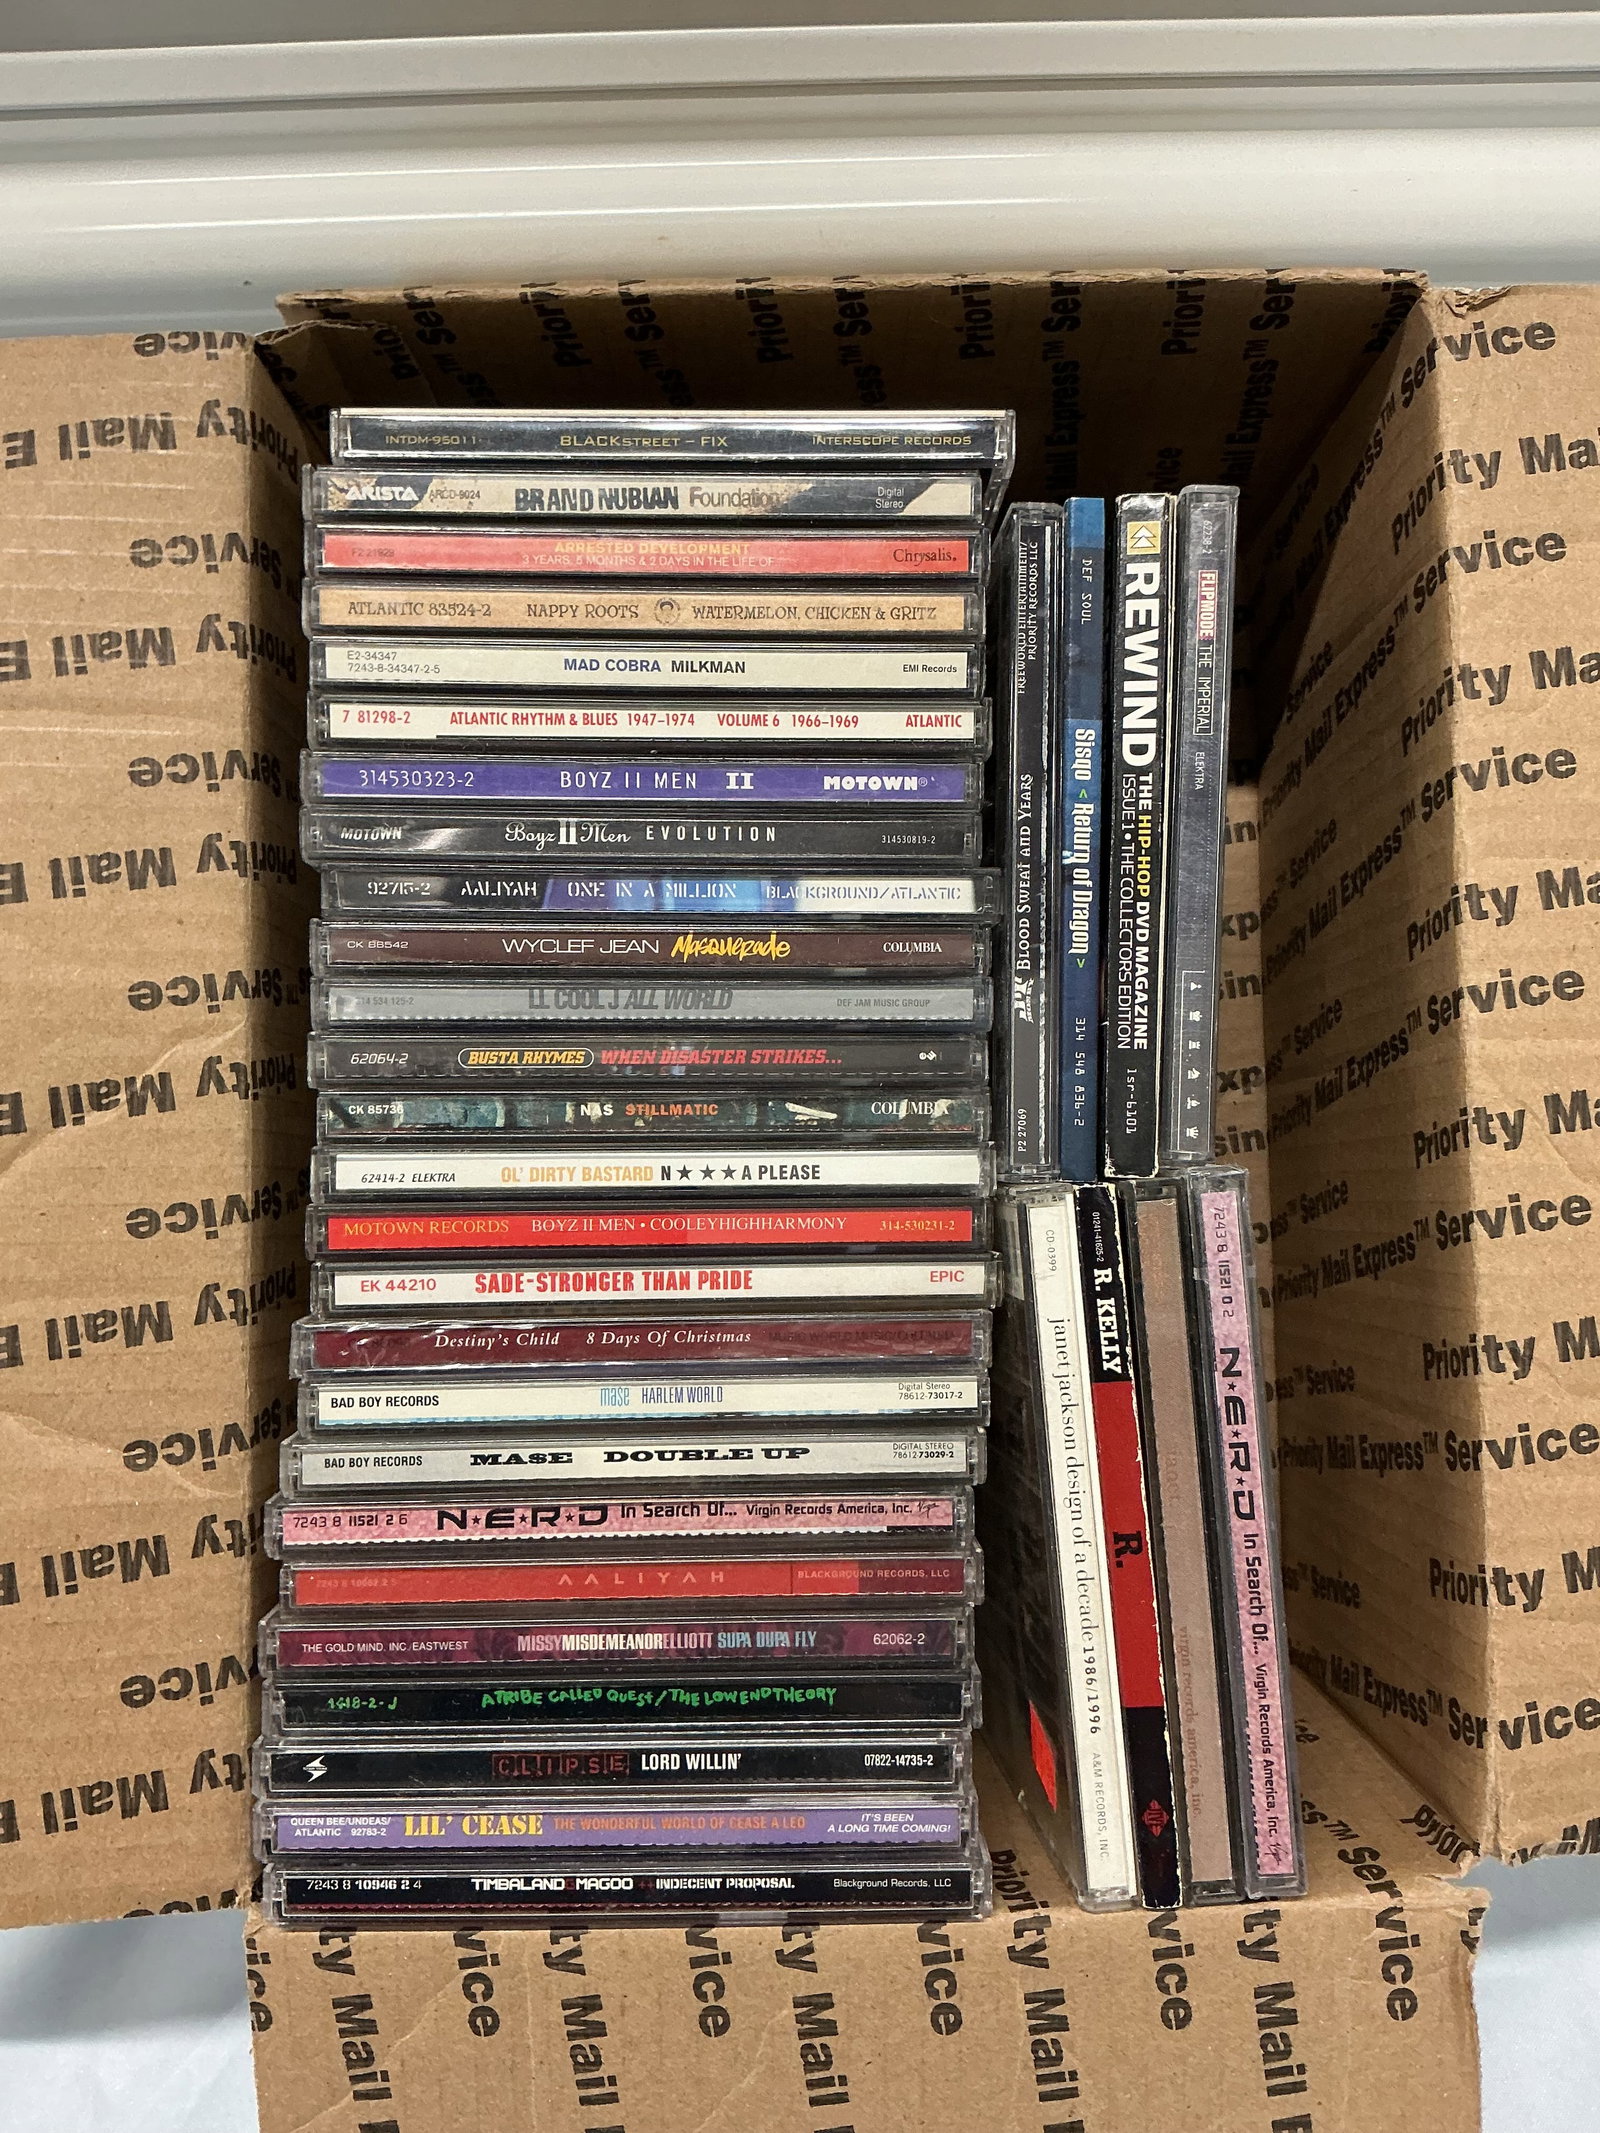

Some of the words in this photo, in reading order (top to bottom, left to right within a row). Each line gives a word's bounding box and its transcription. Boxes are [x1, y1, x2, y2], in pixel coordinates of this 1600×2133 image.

[59, 412, 177, 461] Mail
[701, 436, 728, 447] FIX
[812, 435, 899, 446] INTERSCOPE
[903, 436, 972, 446] RECORDS
[515, 487, 593, 512] BRAND
[599, 486, 679, 511] NUBIAN
[1391, 448, 1501, 554] Priority
[554, 542, 634, 554] ARRESTED
[639, 543, 750, 556] DEVELOPMENT
[659, 556, 690, 567] DAYS
[706, 556, 730, 567] THE
[732, 556, 757, 567] LIFE
[1082, 559, 1093, 583] DEF
[1413, 529, 1567, 614] Service
[347, 601, 424, 616] ATLANTIC
[527, 603, 578, 618] NAPPY
[584, 603, 639, 619] ROOTS
[804, 605, 871, 620] CHICKEN
[890, 605, 937, 621] GRITZ
[1081, 593, 1092, 624] SOUL
[564, 658, 600, 671] MAD
[605, 659, 662, 673] COBRA
[671, 660, 746, 674] MILKMAN
[902, 664, 920, 673] EMI
[922, 664, 958, 673] Records
[1121, 561, 1160, 767] REWIND
[1198, 644, 1212, 669] THE
[357, 710, 411, 725] 81298-2
[450, 711, 508, 726] ATLANTIC
[512, 711, 566, 726] RHYTHM
[582, 712, 618, 727] BLUES
[717, 713, 769, 727] VOLUME
[905, 714, 963, 728] ATLANTIC
[1195, 676, 1211, 733] IMPERIAL
[1402, 663, 1511, 754] Priority
[359, 769, 475, 788] 314530323-2
[560, 771, 612, 789] BOYZ
[654, 772, 697, 790] MEN
[1194, 750, 1205, 791] ELEKTRA
[1421, 747, 1576, 823] Service
[1138, 772, 1153, 811] THE
[505, 821, 556, 851] Boyz
[581, 822, 632, 843] Men
[646, 825, 776, 842] EVOLUTION
[49, 847, 177, 899] Mail
[1120, 843, 1135, 875] THE
[1136, 814, 1152, 898] HIP-HOP
[461, 881, 537, 897] AALIYAH
[568, 882, 605, 898] ONE
[665, 882, 737, 899] MILLION
[1067, 889, 1092, 954] Dragon
[1117, 877, 1134, 982] COLLECTORS
[1135, 901, 1150, 942] DVD
[1407, 882, 1518, 963] Priority
[502, 938, 594, 954] WYCLEF
[599, 939, 660, 954] JEAN
[883, 941, 943, 953] COLUMBIA
[854, 998, 872, 1008] JAM
[873, 998, 900, 1008] MUSIC
[901, 998, 931, 1008] GROUP
[1133, 947, 1149, 1050] MAGAZINE
[1427, 968, 1584, 1036] Service
[1117, 984, 1132, 1049] EDITION
[350, 1053, 409, 1065] 62064-2
[467, 1050, 519, 1064] BUSTA
[522, 1051, 586, 1065] RHYMES
[601, 1051, 660, 1065] WHEN
[660, 1050, 746, 1065] DISASTER
[625, 1103, 719, 1117] STILLMATIC
[1018, 1107, 1027, 1139] 27069
[1414, 1106, 1525, 1169] Priority
[361, 1173, 405, 1184] 62414-2
[411, 1173, 456, 1183] ELEKTRA
[529, 1165, 577, 1183] DIRTY
[582, 1165, 654, 1182] BASTARD
[758, 1164, 821, 1180] PLEASE
[344, 1220, 424, 1236] MOTOWN
[429, 1219, 510, 1234] RECORDS
[531, 1218, 578, 1232] BOYZ
[598, 1218, 636, 1232] MEN
[650, 1216, 847, 1231] COOLEYHIGHHARMONY
[879, 1219, 955, 1232] 314-530231-2
[360, 1280, 381, 1293] EK
[385, 1278, 437, 1292] 44210
[641, 1270, 691, 1292] THAN
[697, 1269, 753, 1291] PRIDE
[929, 1270, 965, 1283] EPIC
[516, 1332, 560, 1346] Child
[601, 1331, 641, 1349] Days
[647, 1330, 670, 1348] Of
[673, 1329, 752, 1345] Christmas
[1047, 1318, 1071, 1368] janet
[1096, 1297, 1122, 1374] KELLY
[330, 1397, 356, 1408] BAD
[358, 1396, 382, 1408] BOY
[385, 1395, 439, 1408] RECORDS
[641, 1386, 684, 1404] HARLEM
[686, 1386, 723, 1403] WORLD
[898, 1390, 963, 1401] 78612-73017-2
[1053, 1374, 1080, 1450] jackson
[324, 1457, 346, 1469] BAD
[348, 1457, 371, 1468] BOY
[373, 1455, 423, 1467] RECORDS
[603, 1446, 754, 1463] DOUBLE
[760, 1446, 811, 1460] UP
[893, 1450, 955, 1460] 78612-73029-2
[1445, 1420, 1600, 1474] Service
[1063, 1456, 1086, 1521] design
[643, 1501, 700, 1519] Search
[746, 1503, 780, 1519] Virgin
[784, 1502, 833, 1515] Records
[41, 1535, 170, 1598] Mail
[930, 1569, 951, 1578] LLC
[1245, 1556, 1264, 1617] Search
[302, 1642, 323, 1653] THE
[325, 1642, 354, 1653] GOLD
[717, 1630, 753, 1649] SUPA
[756, 1630, 791, 1648] DUPA
[794, 1630, 817, 1648] FLY
[873, 1633, 926, 1646] 62062-2
[640, 1753, 681, 1770] LORD
[863, 1754, 934, 1767] 07822-14735-2
[290, 1816, 324, 1826] QUEEN
[461, 1813, 543, 1836] CEASE
[580, 1817, 657, 1830] WONDERFUL
[660, 1816, 705, 1830] WORLD
[294, 1827, 342, 1837] ATLANTIC
[351, 1827, 387, 1837] 92783-2
[872, 1824, 900, 1833] TIME
[900, 1822, 951, 1833] COMING!
[470, 1877, 564, 1891] TIMBALAND
[575, 1877, 634, 1891] MAGOO
[655, 1876, 723, 1890] INDECENT
[833, 1878, 888, 1889] Blackground
[933, 1878, 952, 1888] LLC
[1338, 1845, 1421, 2023] Service
[331, 1993, 392, 2104] Mail
[561, 1992, 619, 2108] Mail
[793, 1991, 854, 2108] Mail
[1023, 1988, 1083, 2104] Mail
[1253, 1981, 1310, 2098] Mail
